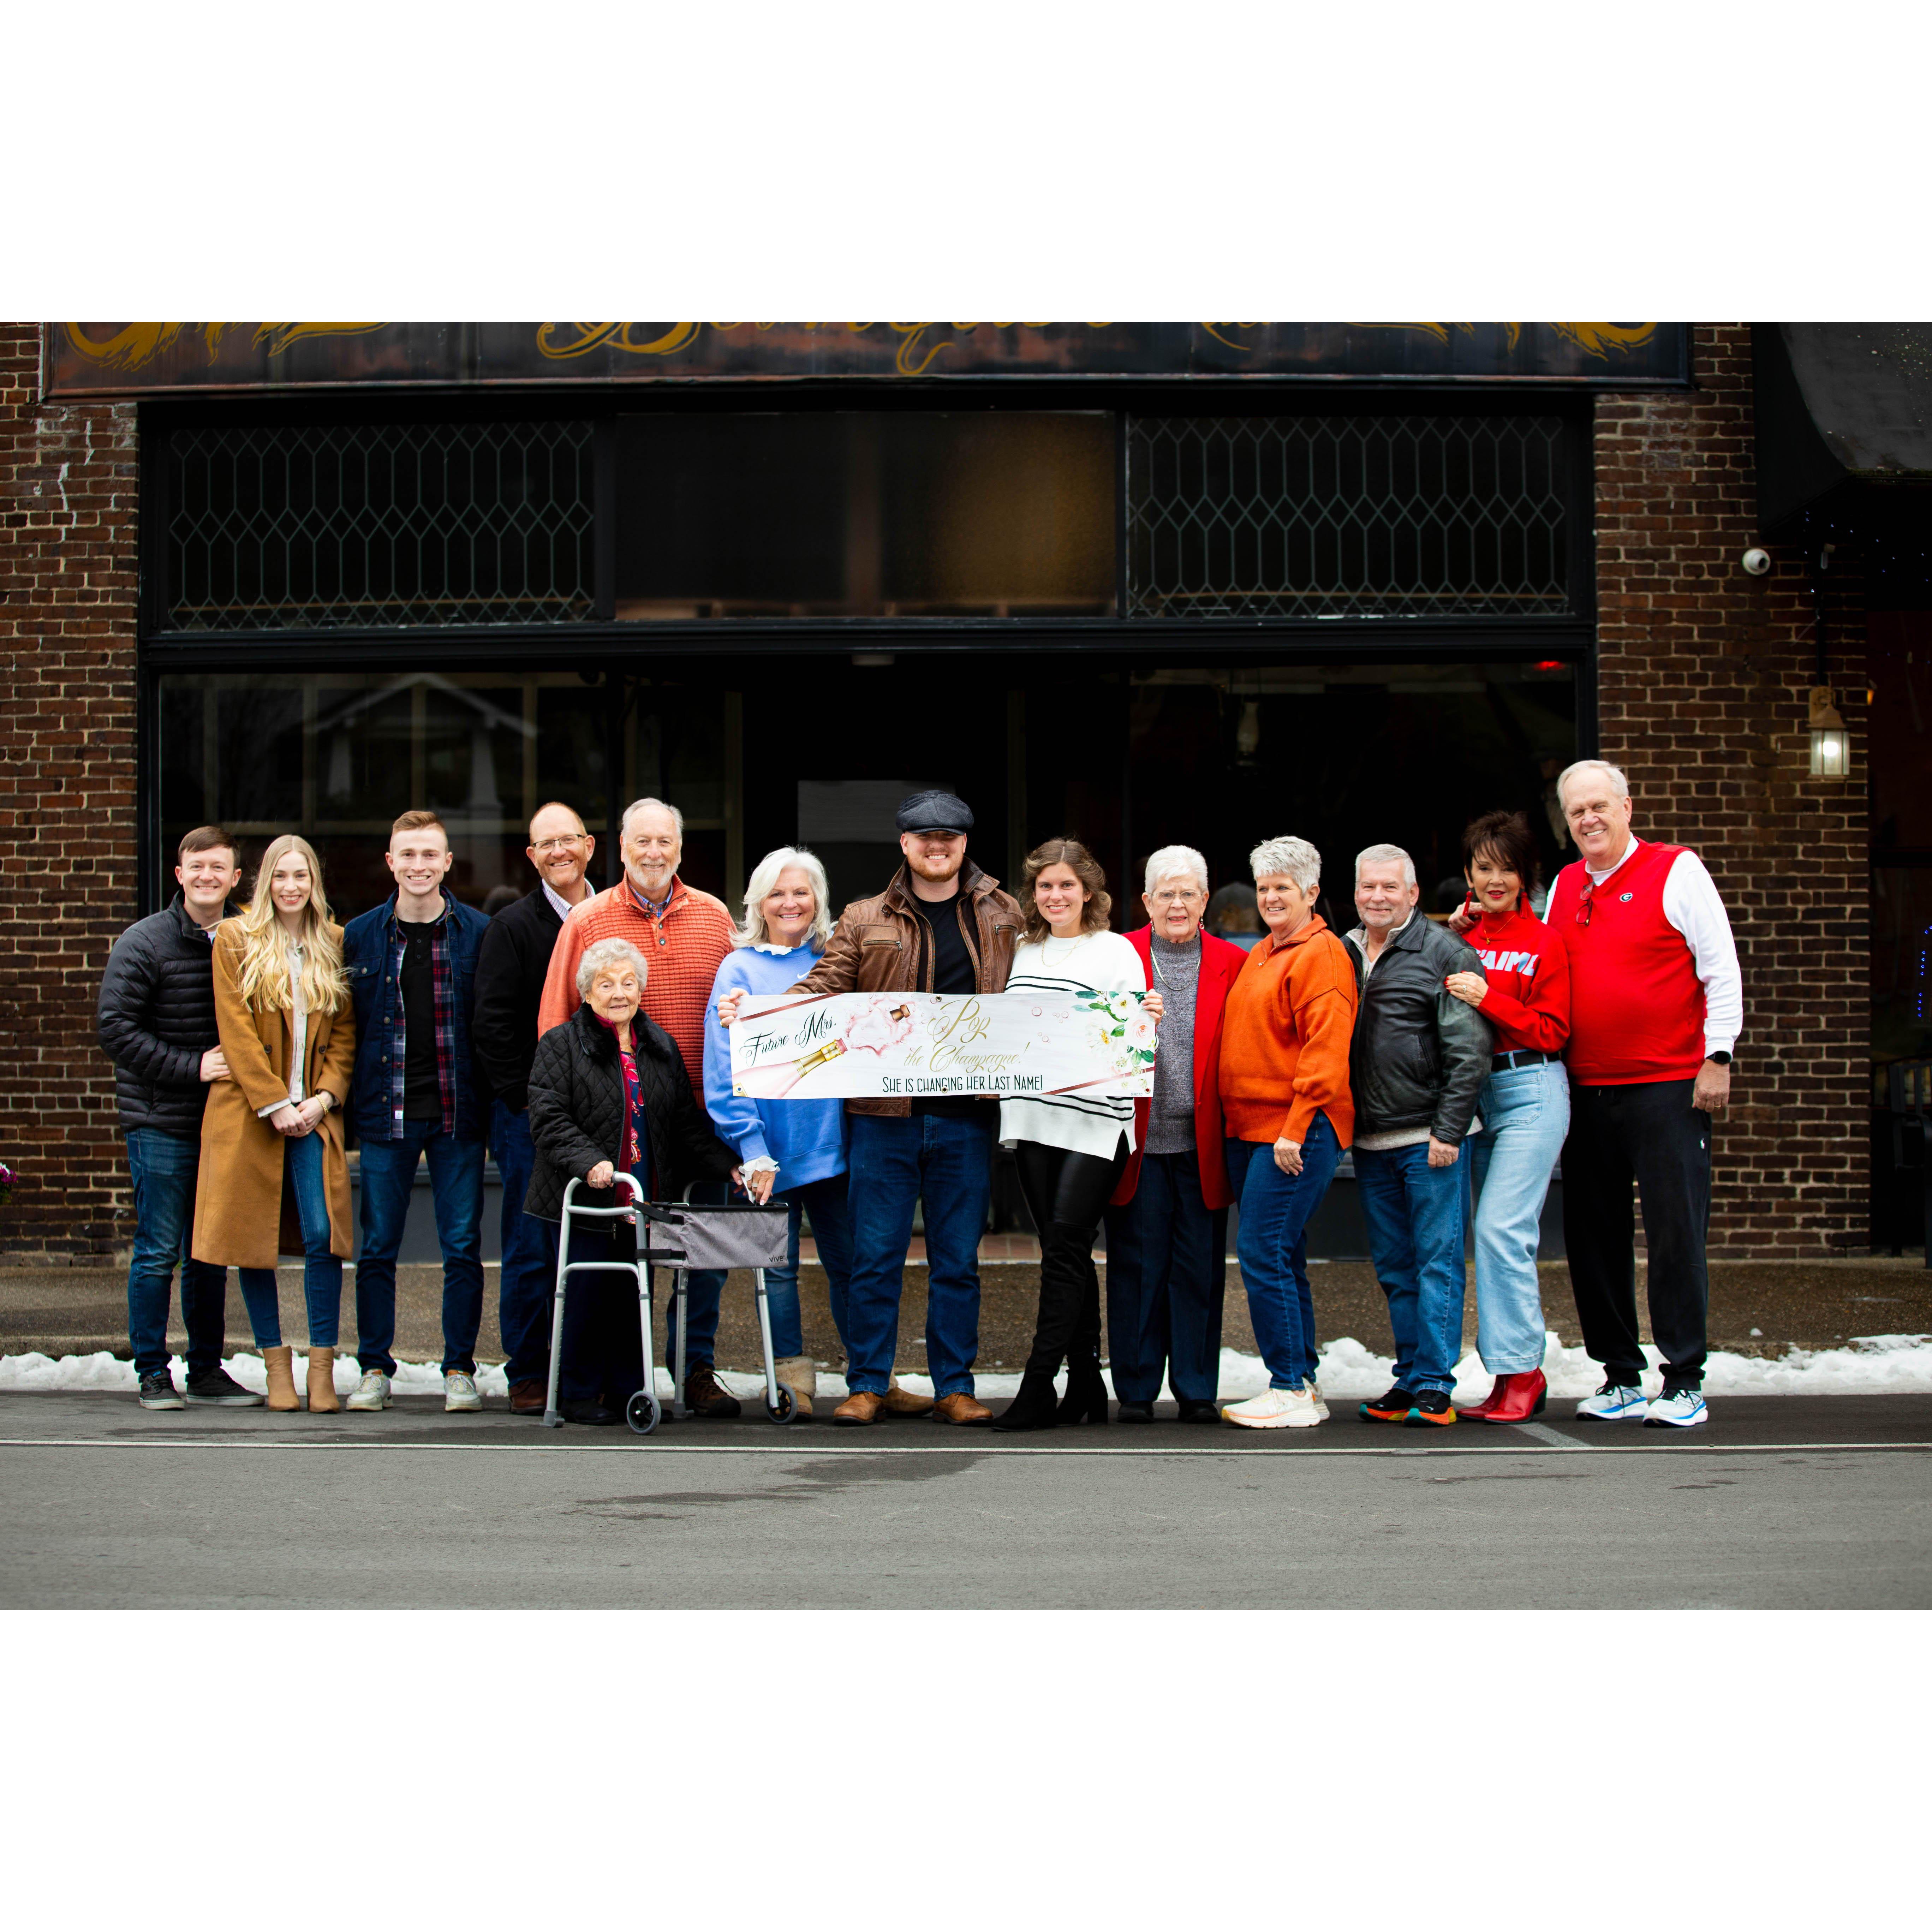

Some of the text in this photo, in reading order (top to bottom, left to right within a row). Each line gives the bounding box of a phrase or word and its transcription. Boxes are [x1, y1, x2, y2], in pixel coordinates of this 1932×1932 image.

[1621, 893, 1632, 901] G
[1476, 949, 1539, 976] 'AIME
[927, 995, 991, 1043] Pop
[739, 1007, 836, 1067] Future Mrs.
[904, 1041, 1031, 1073] the Champagne!
[883, 1074, 1043, 1092] SHE IS CHANGING HER LAST NAME!
